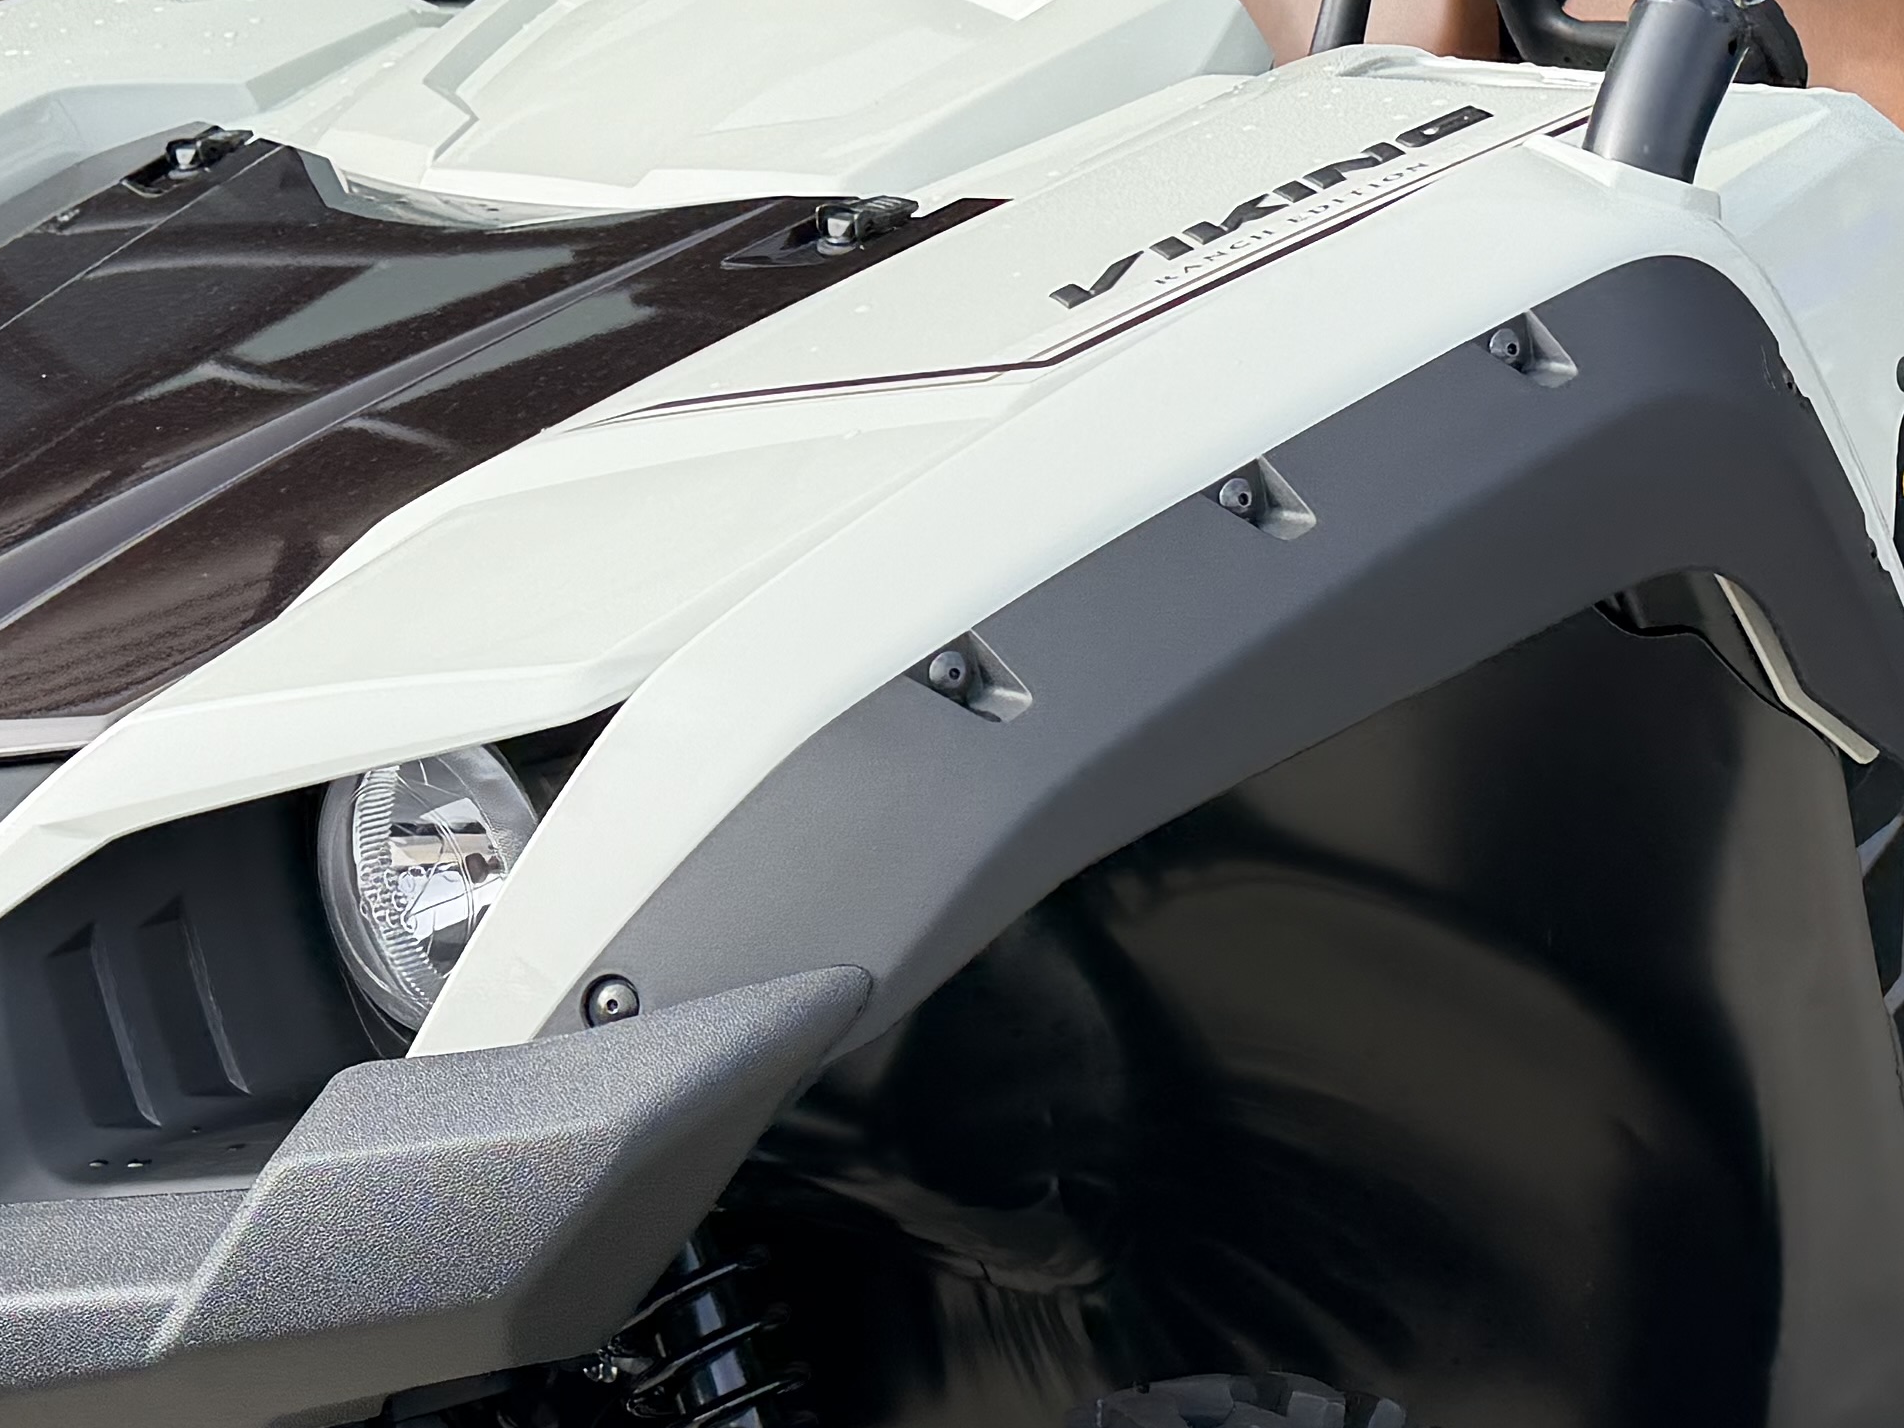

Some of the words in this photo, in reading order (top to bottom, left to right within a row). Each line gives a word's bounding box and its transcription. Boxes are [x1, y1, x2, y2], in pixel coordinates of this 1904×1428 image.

[1049, 105, 1494, 309] VIKING
[1155, 230, 1276, 285] RANCH
[1288, 162, 1430, 224] EDITION
